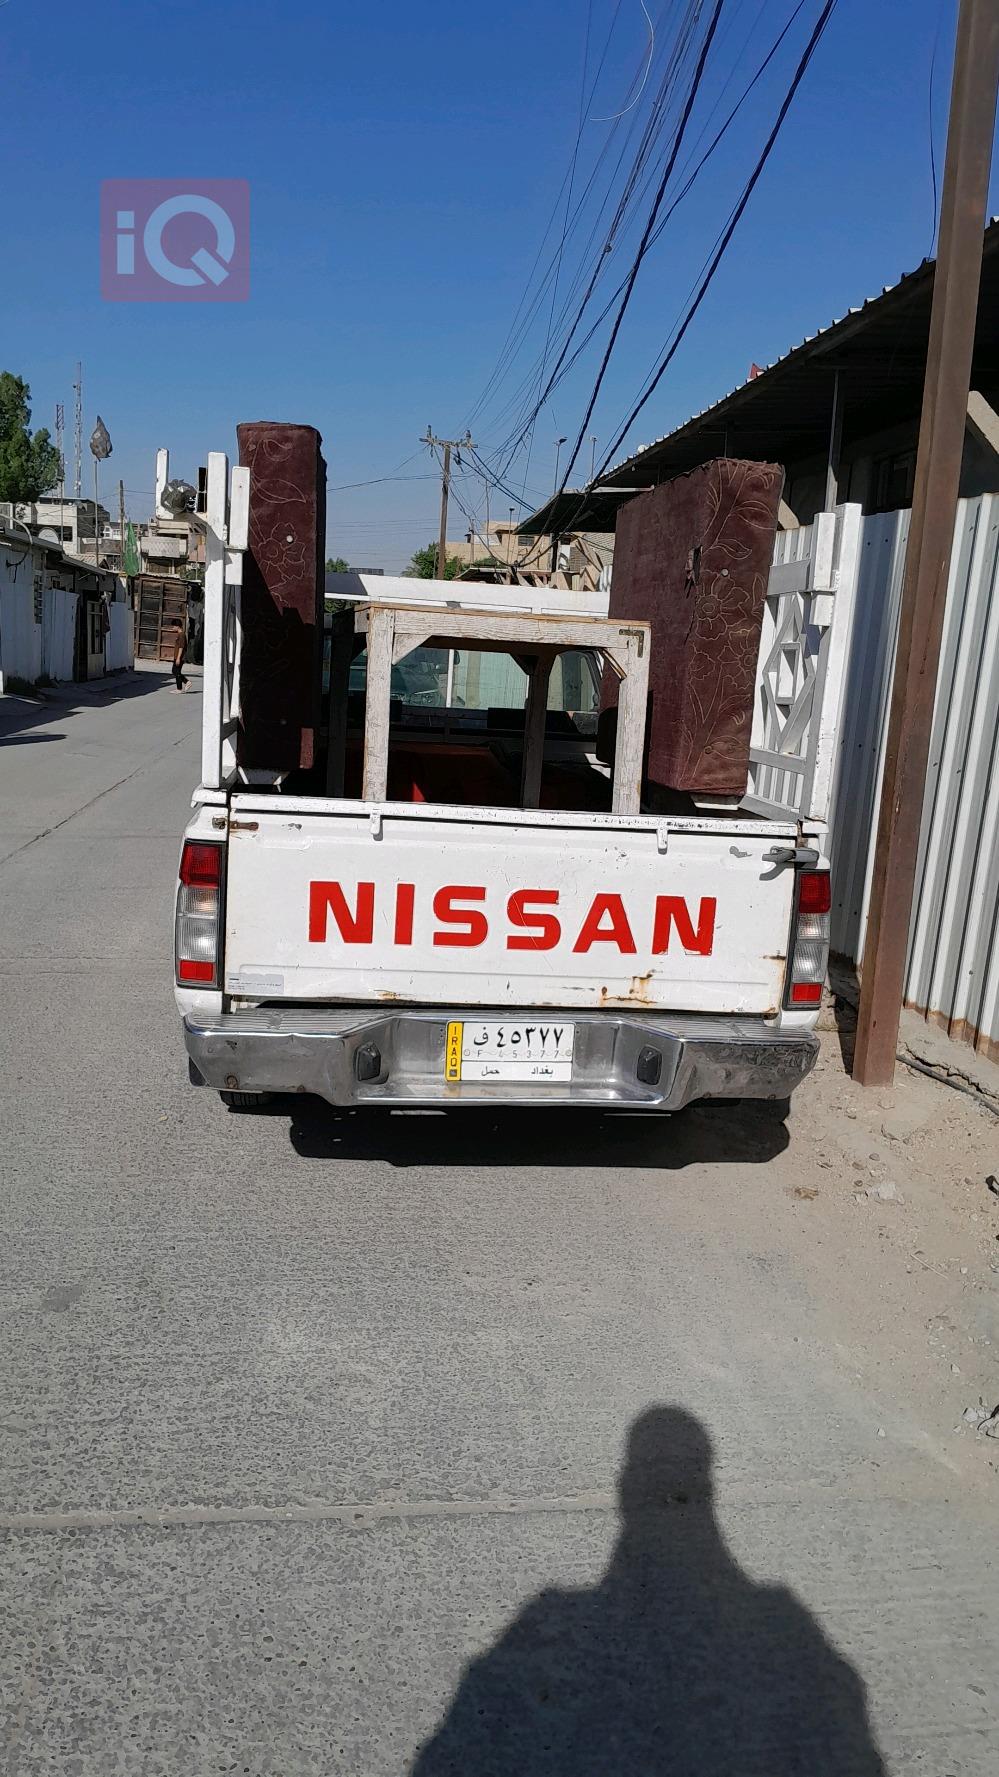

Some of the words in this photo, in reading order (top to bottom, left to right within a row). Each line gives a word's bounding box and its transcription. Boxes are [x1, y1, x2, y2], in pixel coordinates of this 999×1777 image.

[309, 881, 716, 954] NISSAN
[481, 1066, 500, 1076] حمل
[531, 1065, 554, 1077] بغداد
